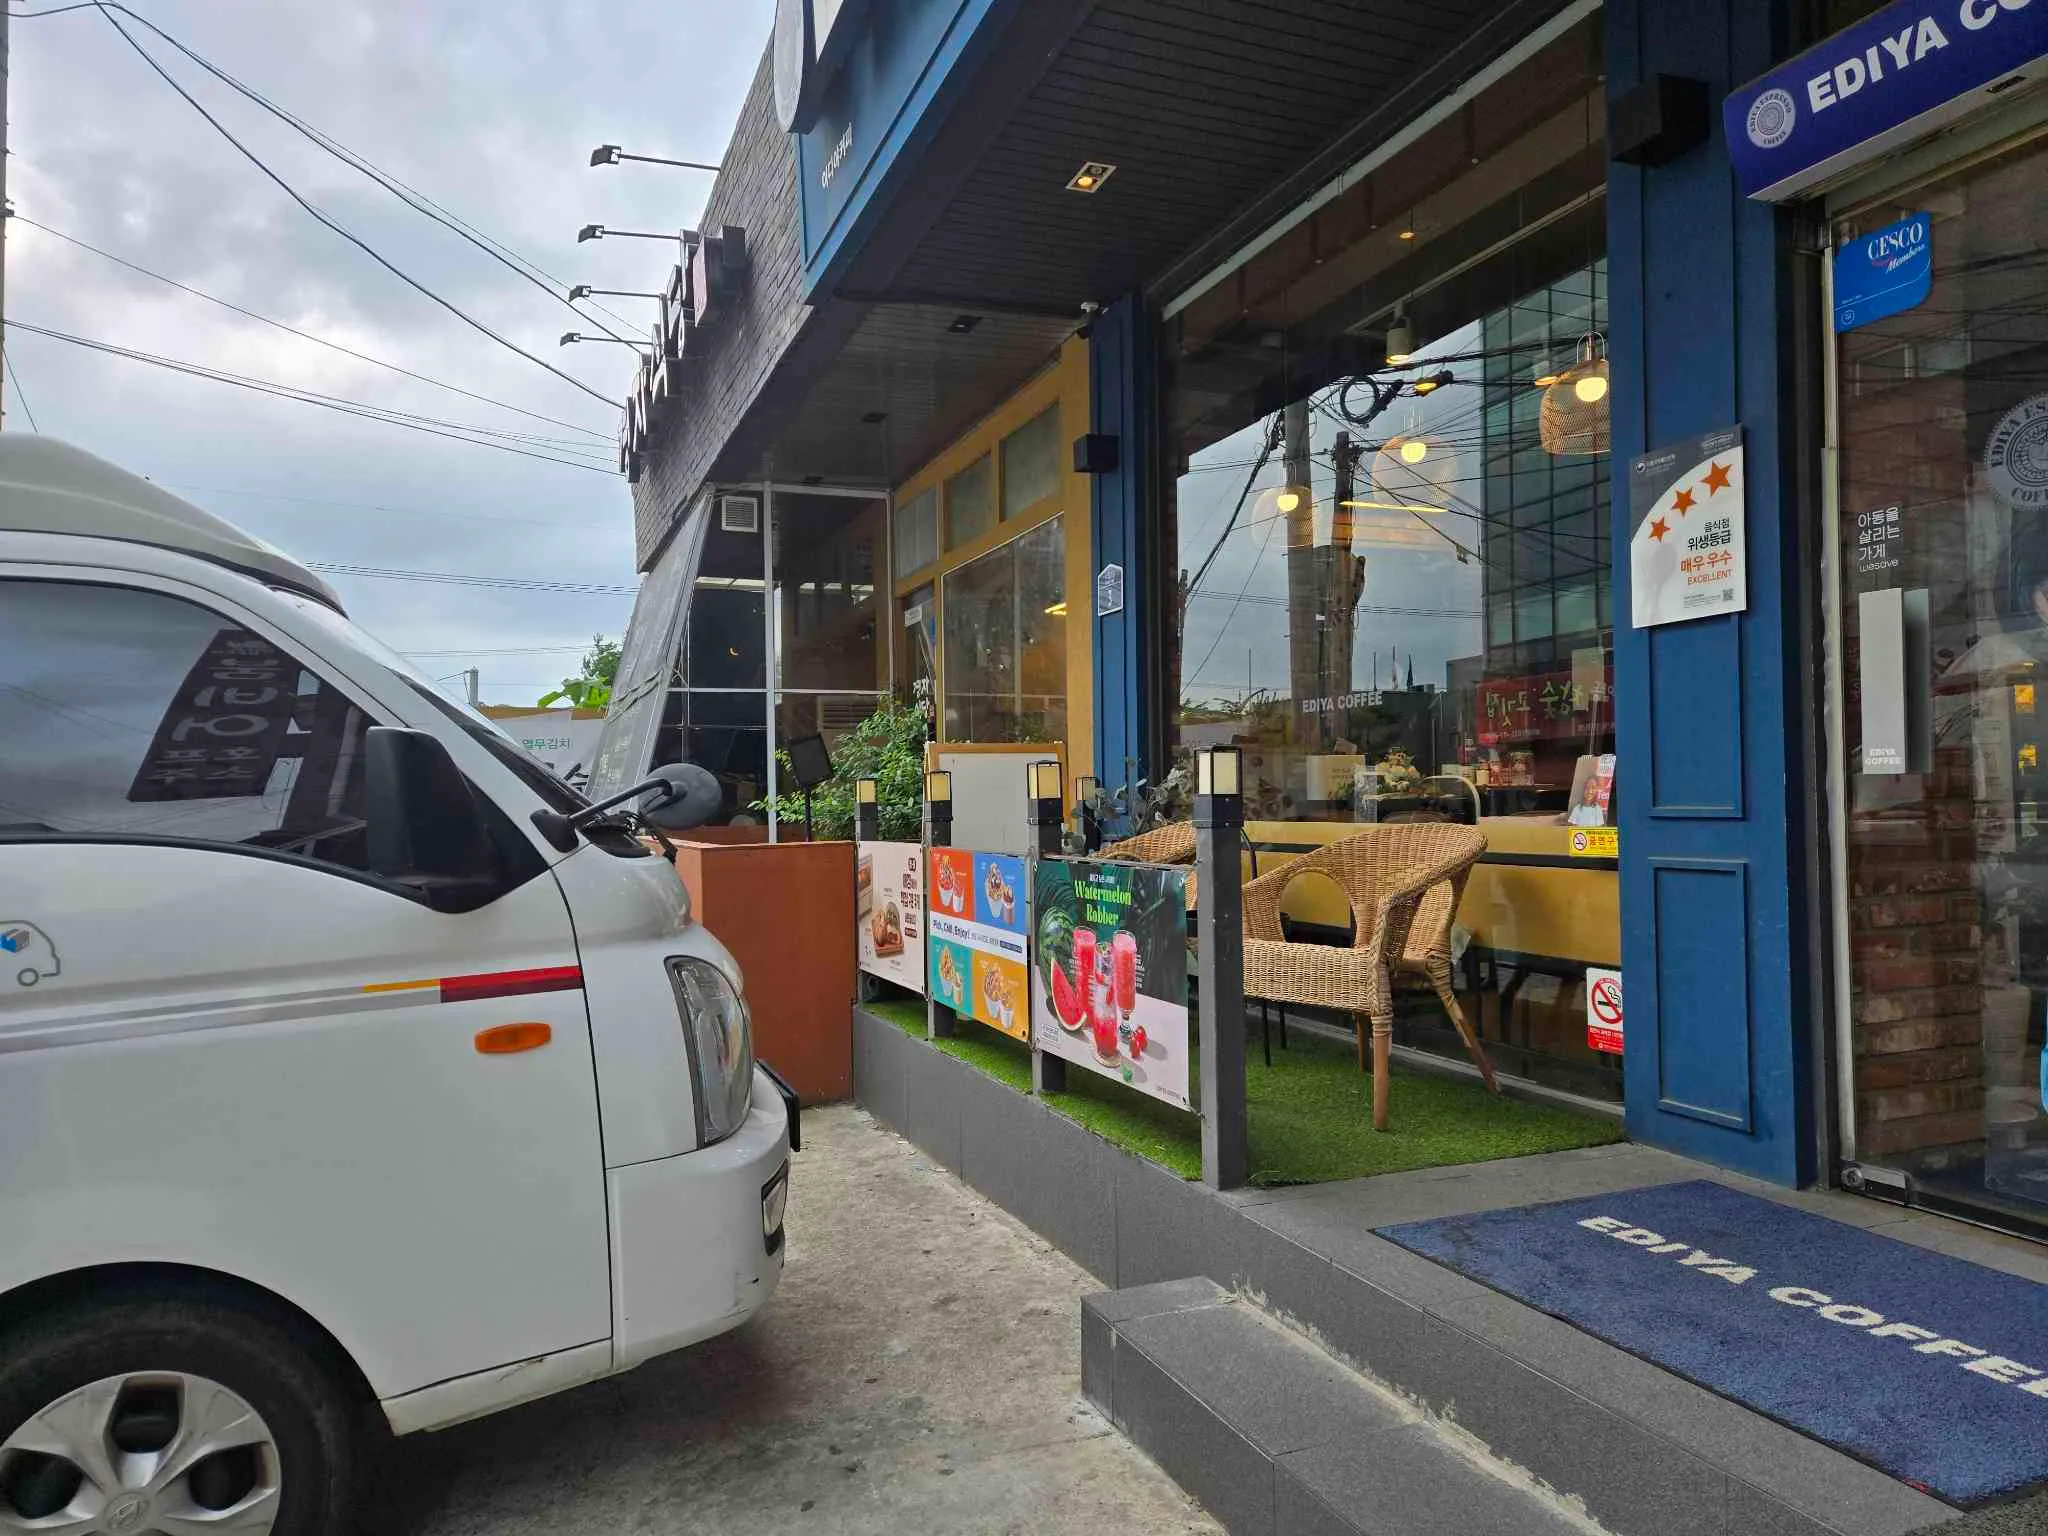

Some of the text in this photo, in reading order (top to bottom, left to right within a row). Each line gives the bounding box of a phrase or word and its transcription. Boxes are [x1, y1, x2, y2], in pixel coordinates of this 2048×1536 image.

[1807, 15, 1949, 114] EDIYA
[821, 121, 853, 191] 이디야커피
[1868, 222, 1923, 260] CESCO
[1704, 518, 1730, 533] 음식점
[1858, 506, 1899, 527] 아동을
[1687, 530, 1731, 551] 위생등급
[1859, 525, 1900, 545] 살리는
[1680, 549, 1733, 573] 매우 우수
[1858, 544, 1886, 560] 가게
[1687, 569, 1733, 585] EXCELLENT
[1302, 690, 1383, 713] EDIYA COFFEE
[523, 738, 570, 751] 열무김치
[1074, 880, 1132, 906] Watermelon
[1577, 1215, 1758, 1285] EDIYA
